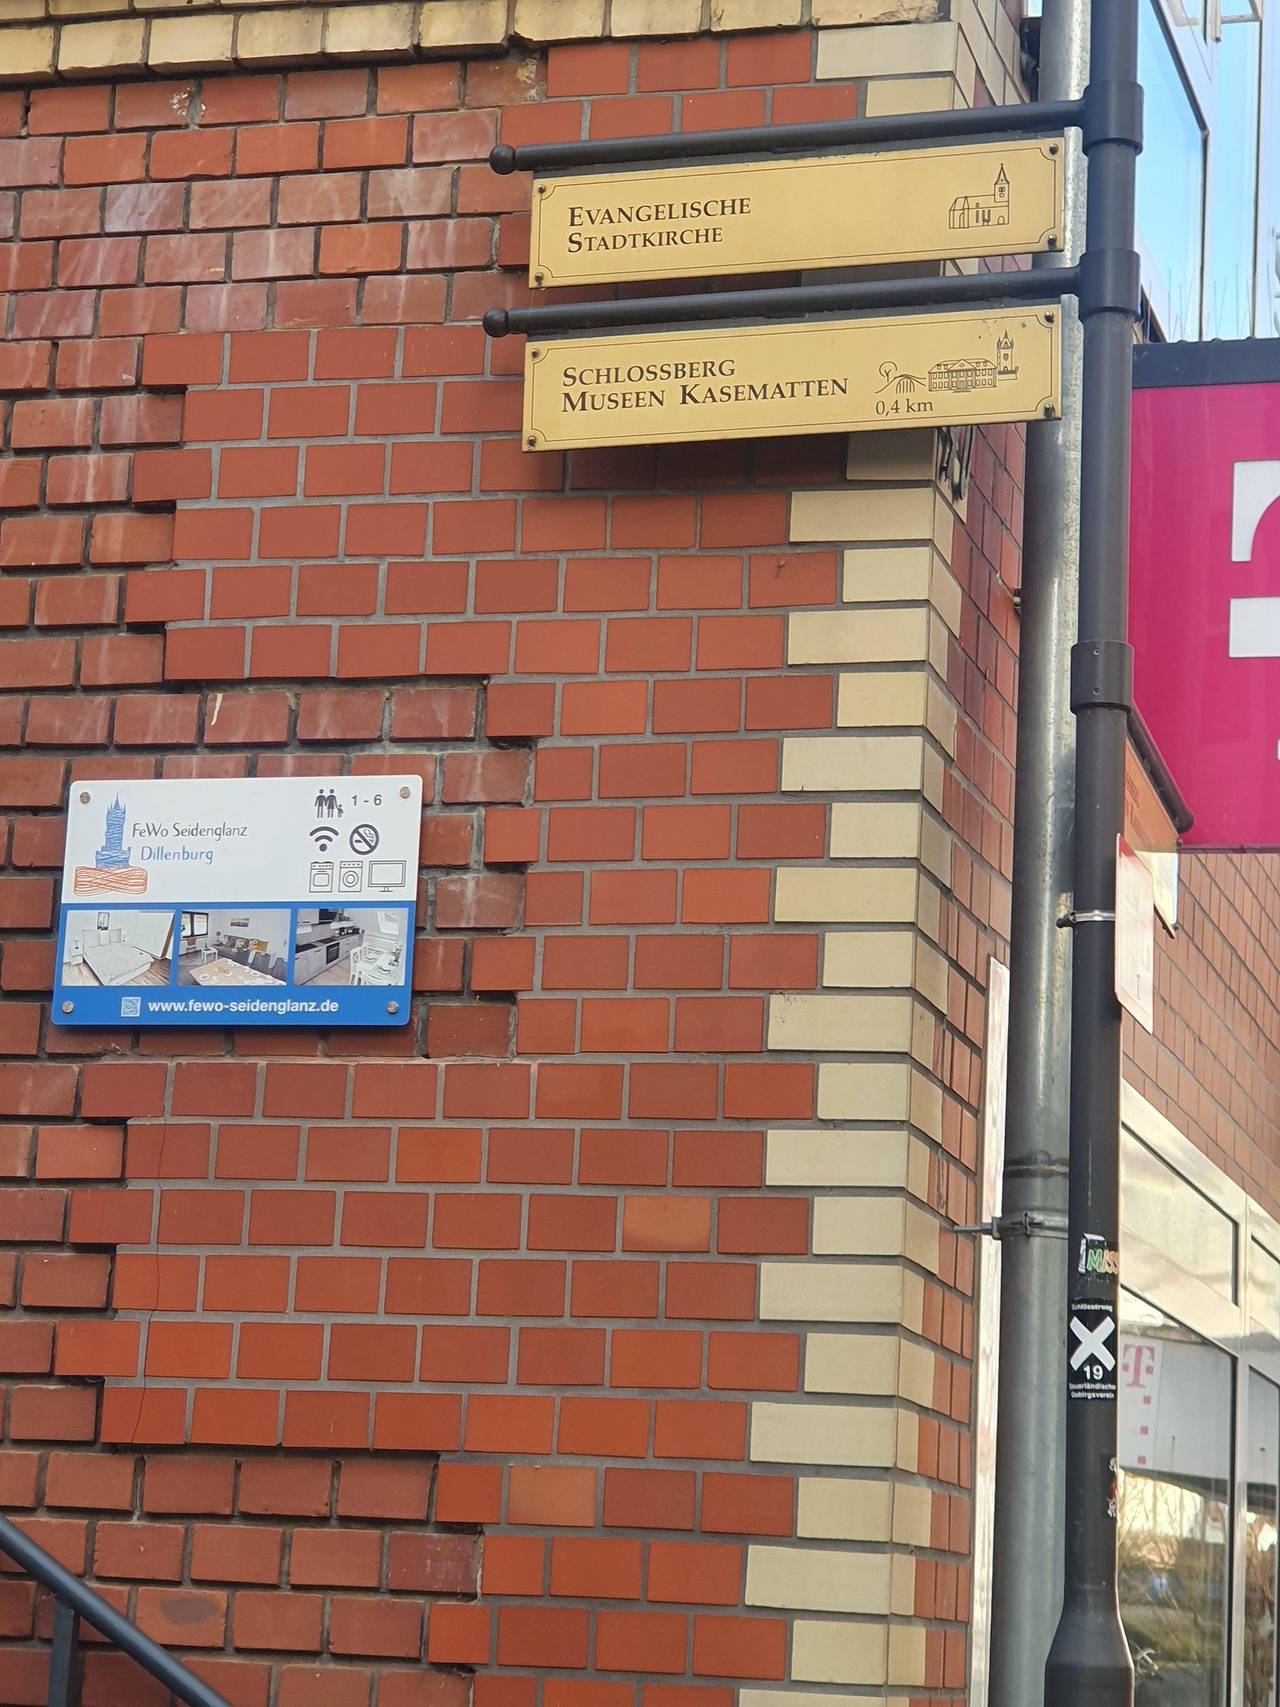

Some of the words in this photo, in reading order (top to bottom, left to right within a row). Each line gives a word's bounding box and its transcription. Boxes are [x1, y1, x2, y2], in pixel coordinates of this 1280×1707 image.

[569, 197, 752, 227] EVANGELISCHE
[568, 226, 723, 253] STADTKIRCHE
[562, 359, 736, 387] SCHLOSSBERG
[562, 389, 665, 413] MUSEEN
[680, 378, 849, 405] KASEMATTEN
[875, 400, 900, 416] 0,4
[905, 398, 934, 413] km
[132, 823, 169, 838] FeWo
[173, 822, 248, 840] Seidenglanz
[141, 846, 213, 864] Dillenburg
[148, 999, 339, 1014] www.fewo-seidenglanz.de
[1083, 1365, 1104, 1380] 19
